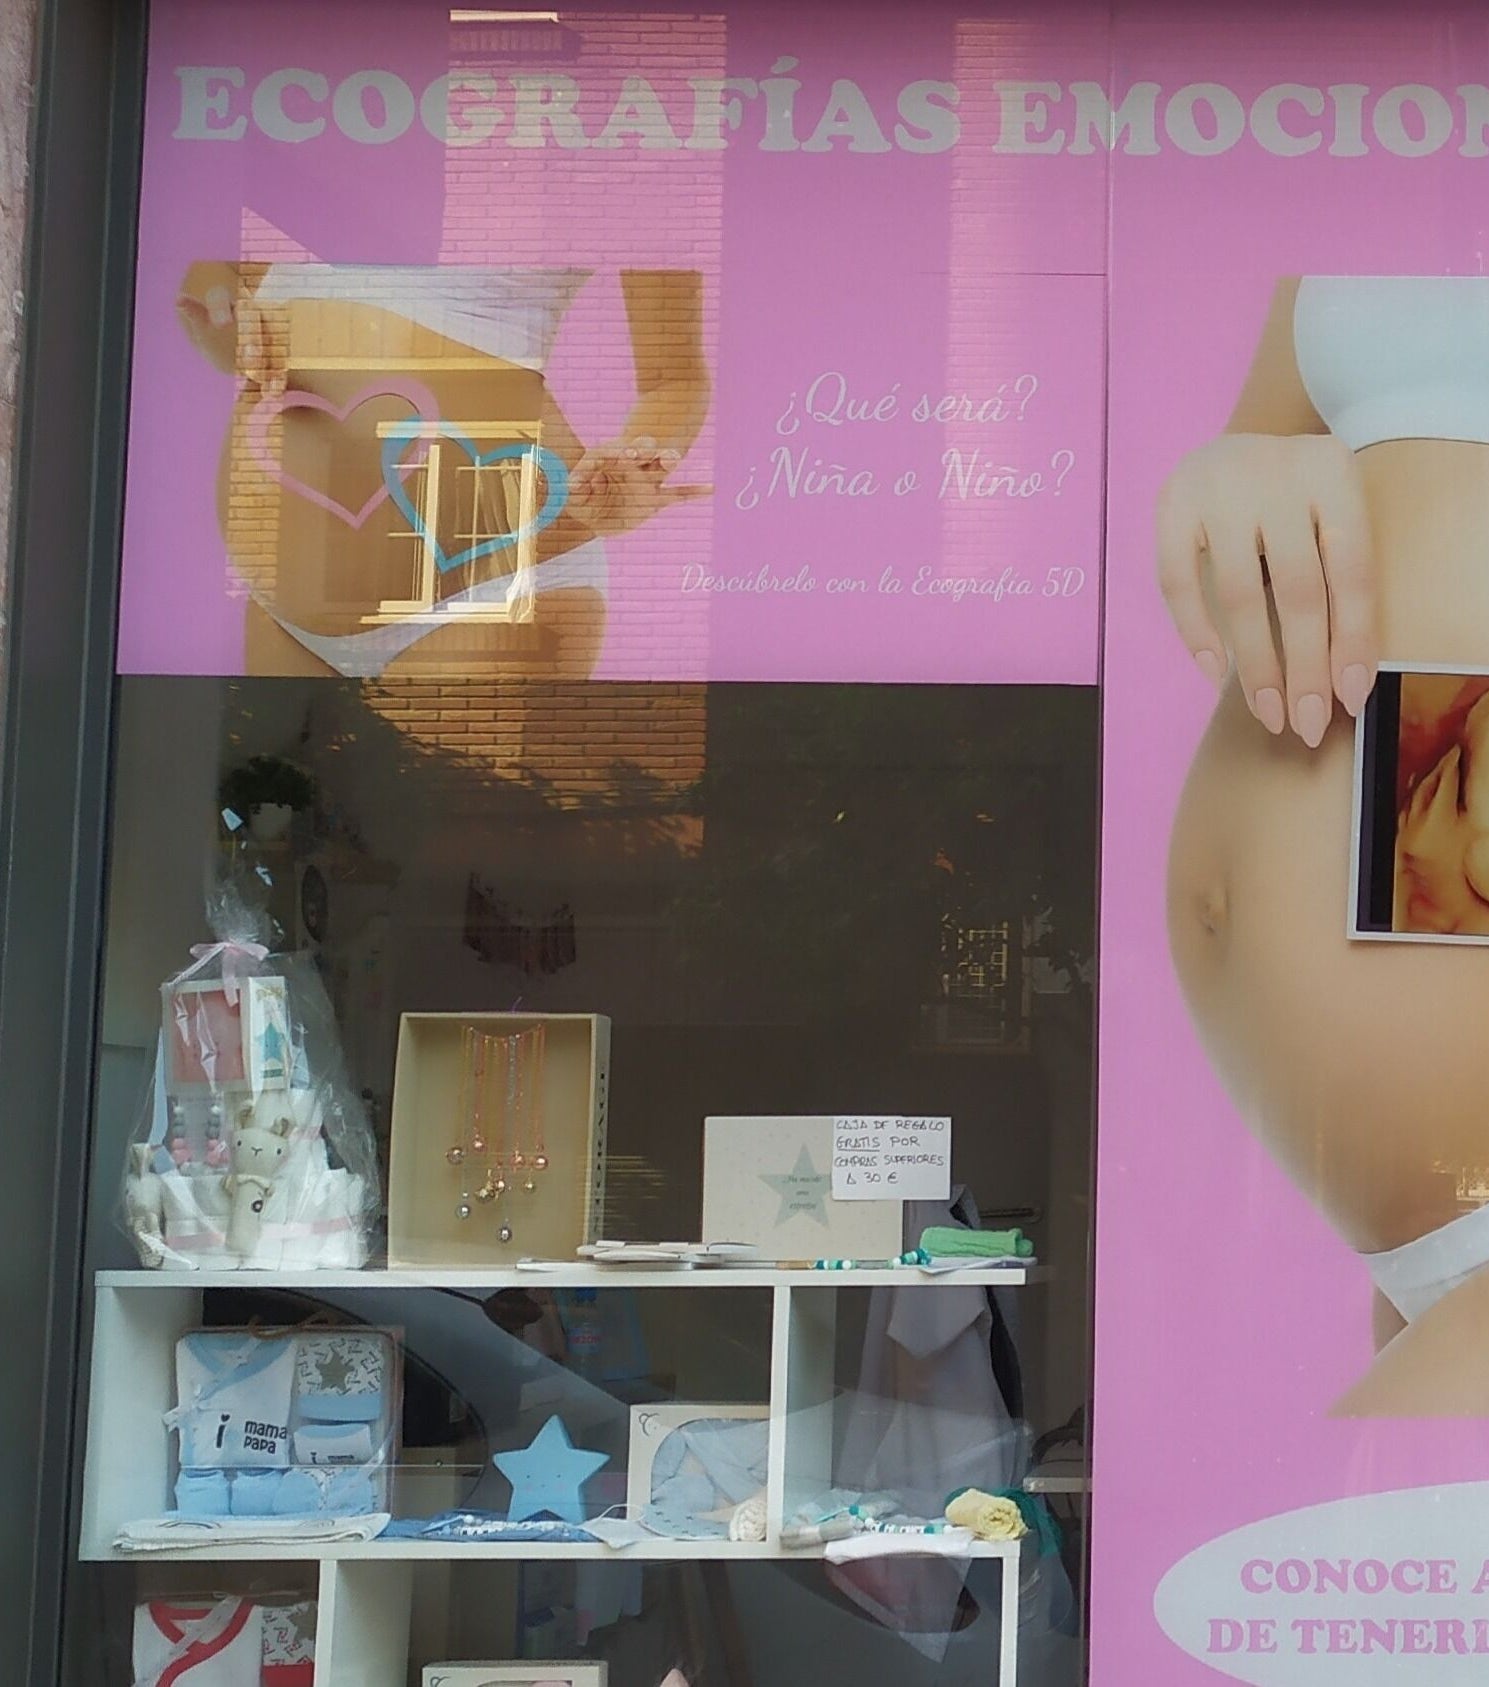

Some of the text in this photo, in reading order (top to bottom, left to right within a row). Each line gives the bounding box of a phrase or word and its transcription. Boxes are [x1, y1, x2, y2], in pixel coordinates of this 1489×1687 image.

[172, 56, 961, 153] ECOGRAFÍAS
[775, 371, 1039, 435] ¿Qué será?
[735, 446, 1075, 510] ¿Niña o Niño?
[681, 562, 1086, 602] Descúbrelo con la Ecografía 5D
[895, 1120, 945, 1131] REGALO
[836, 1136, 921, 1150] GRATIS POR
[834, 1154, 944, 1167] COMPRAS SUPERIORES
[863, 1171, 882, 1183] 30
[887, 1171, 899, 1184] €
[244, 1420, 288, 1440] mama
[243, 1435, 277, 1454] papa
[1239, 1558, 1459, 1596] CONOCE
[1206, 1618, 1278, 1655] DE
